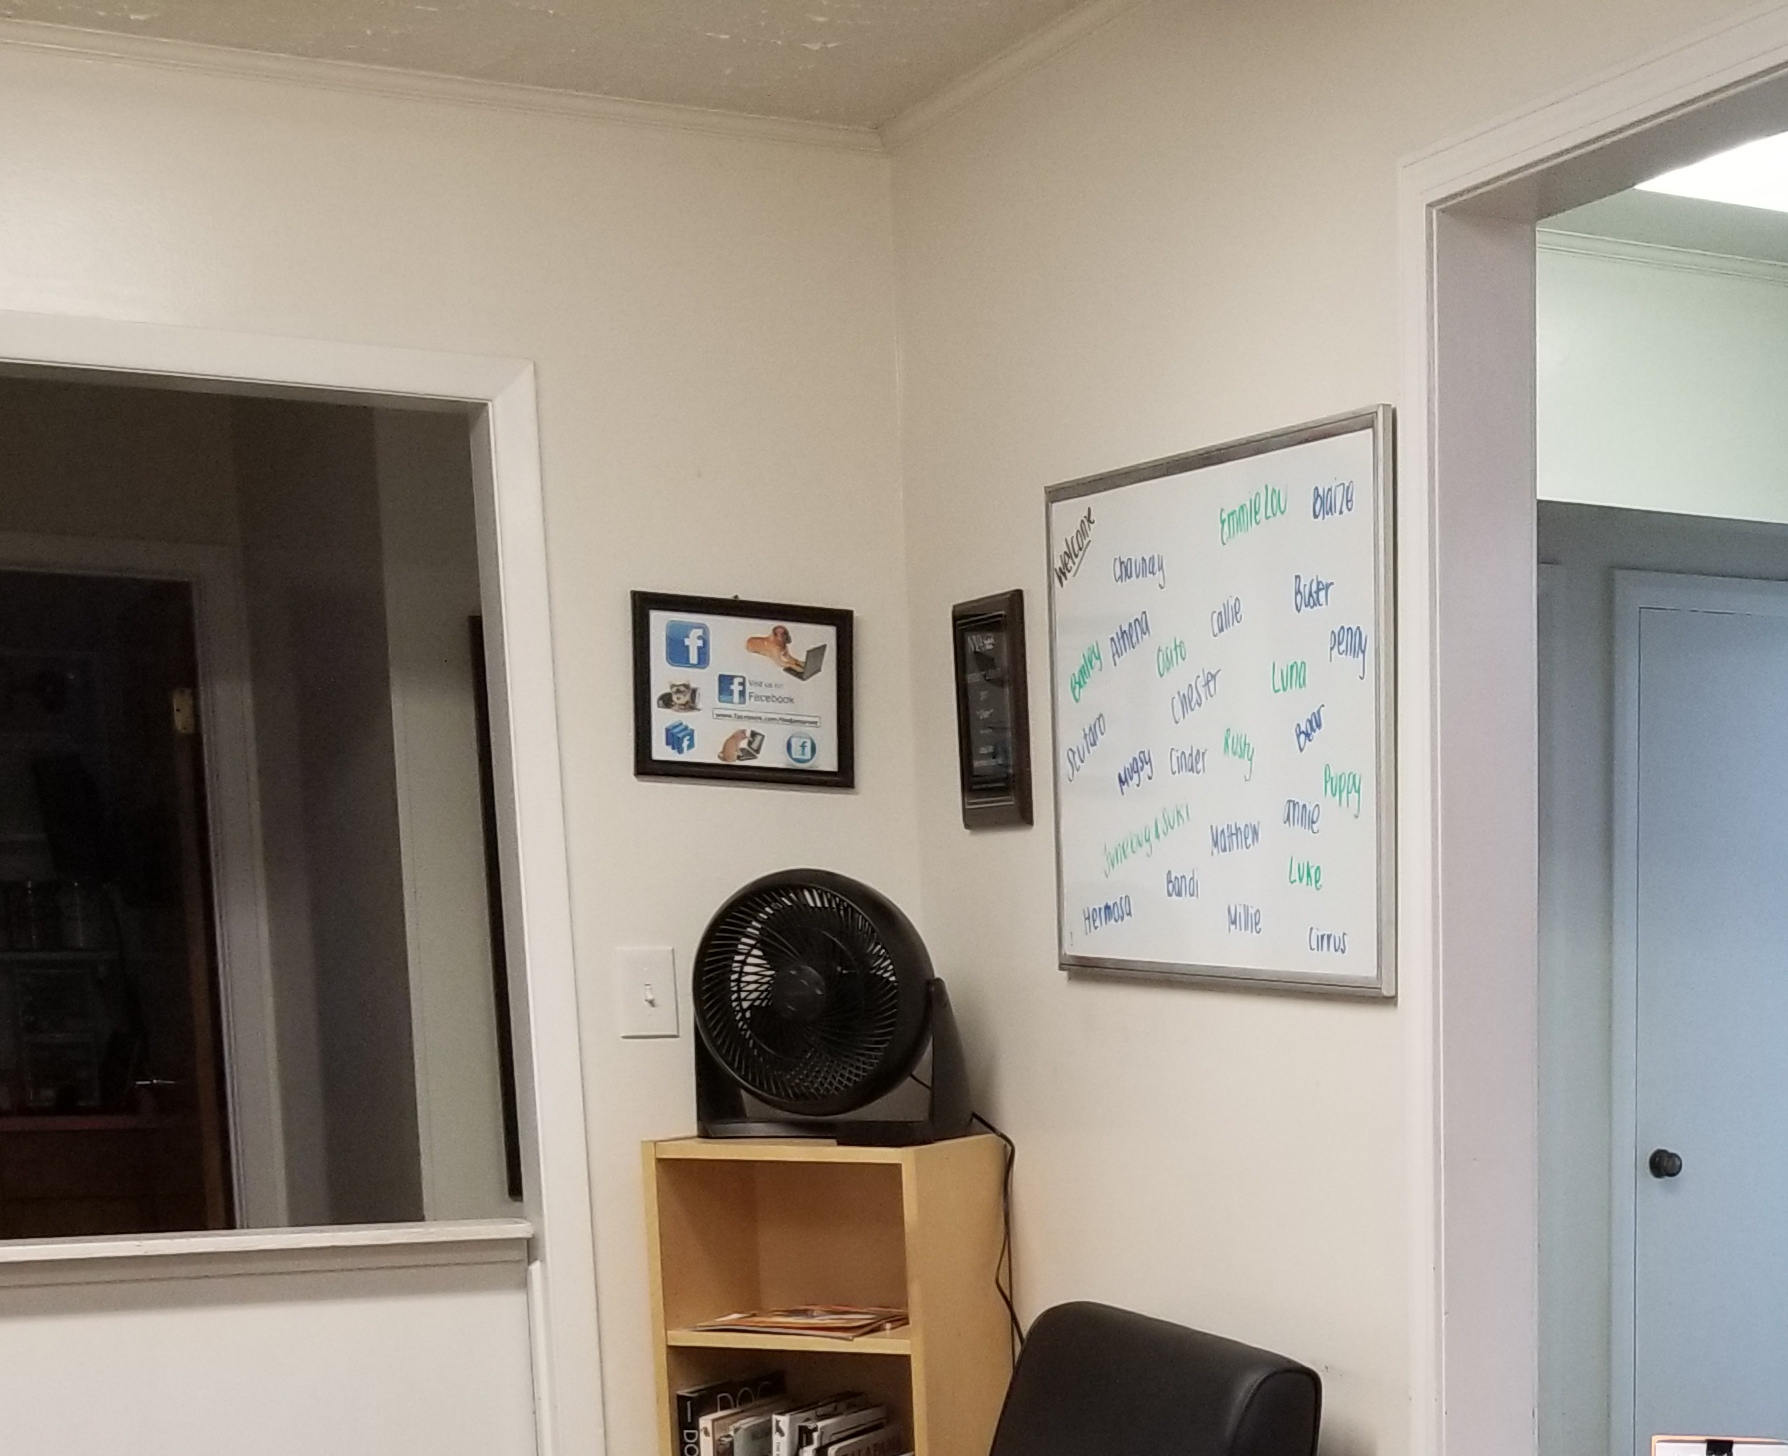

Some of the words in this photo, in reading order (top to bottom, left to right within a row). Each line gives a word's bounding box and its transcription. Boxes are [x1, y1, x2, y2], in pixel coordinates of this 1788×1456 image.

[1054, 506, 1095, 588] Welcome
[1271, 660, 1307, 694] Luna
[1170, 745, 1208, 776] Cinder
[1210, 821, 1260, 856] Matthew
[1289, 856, 1322, 891] Luke
[1227, 904, 1262, 934] Millie
[1308, 926, 1348, 954] Cirrus
